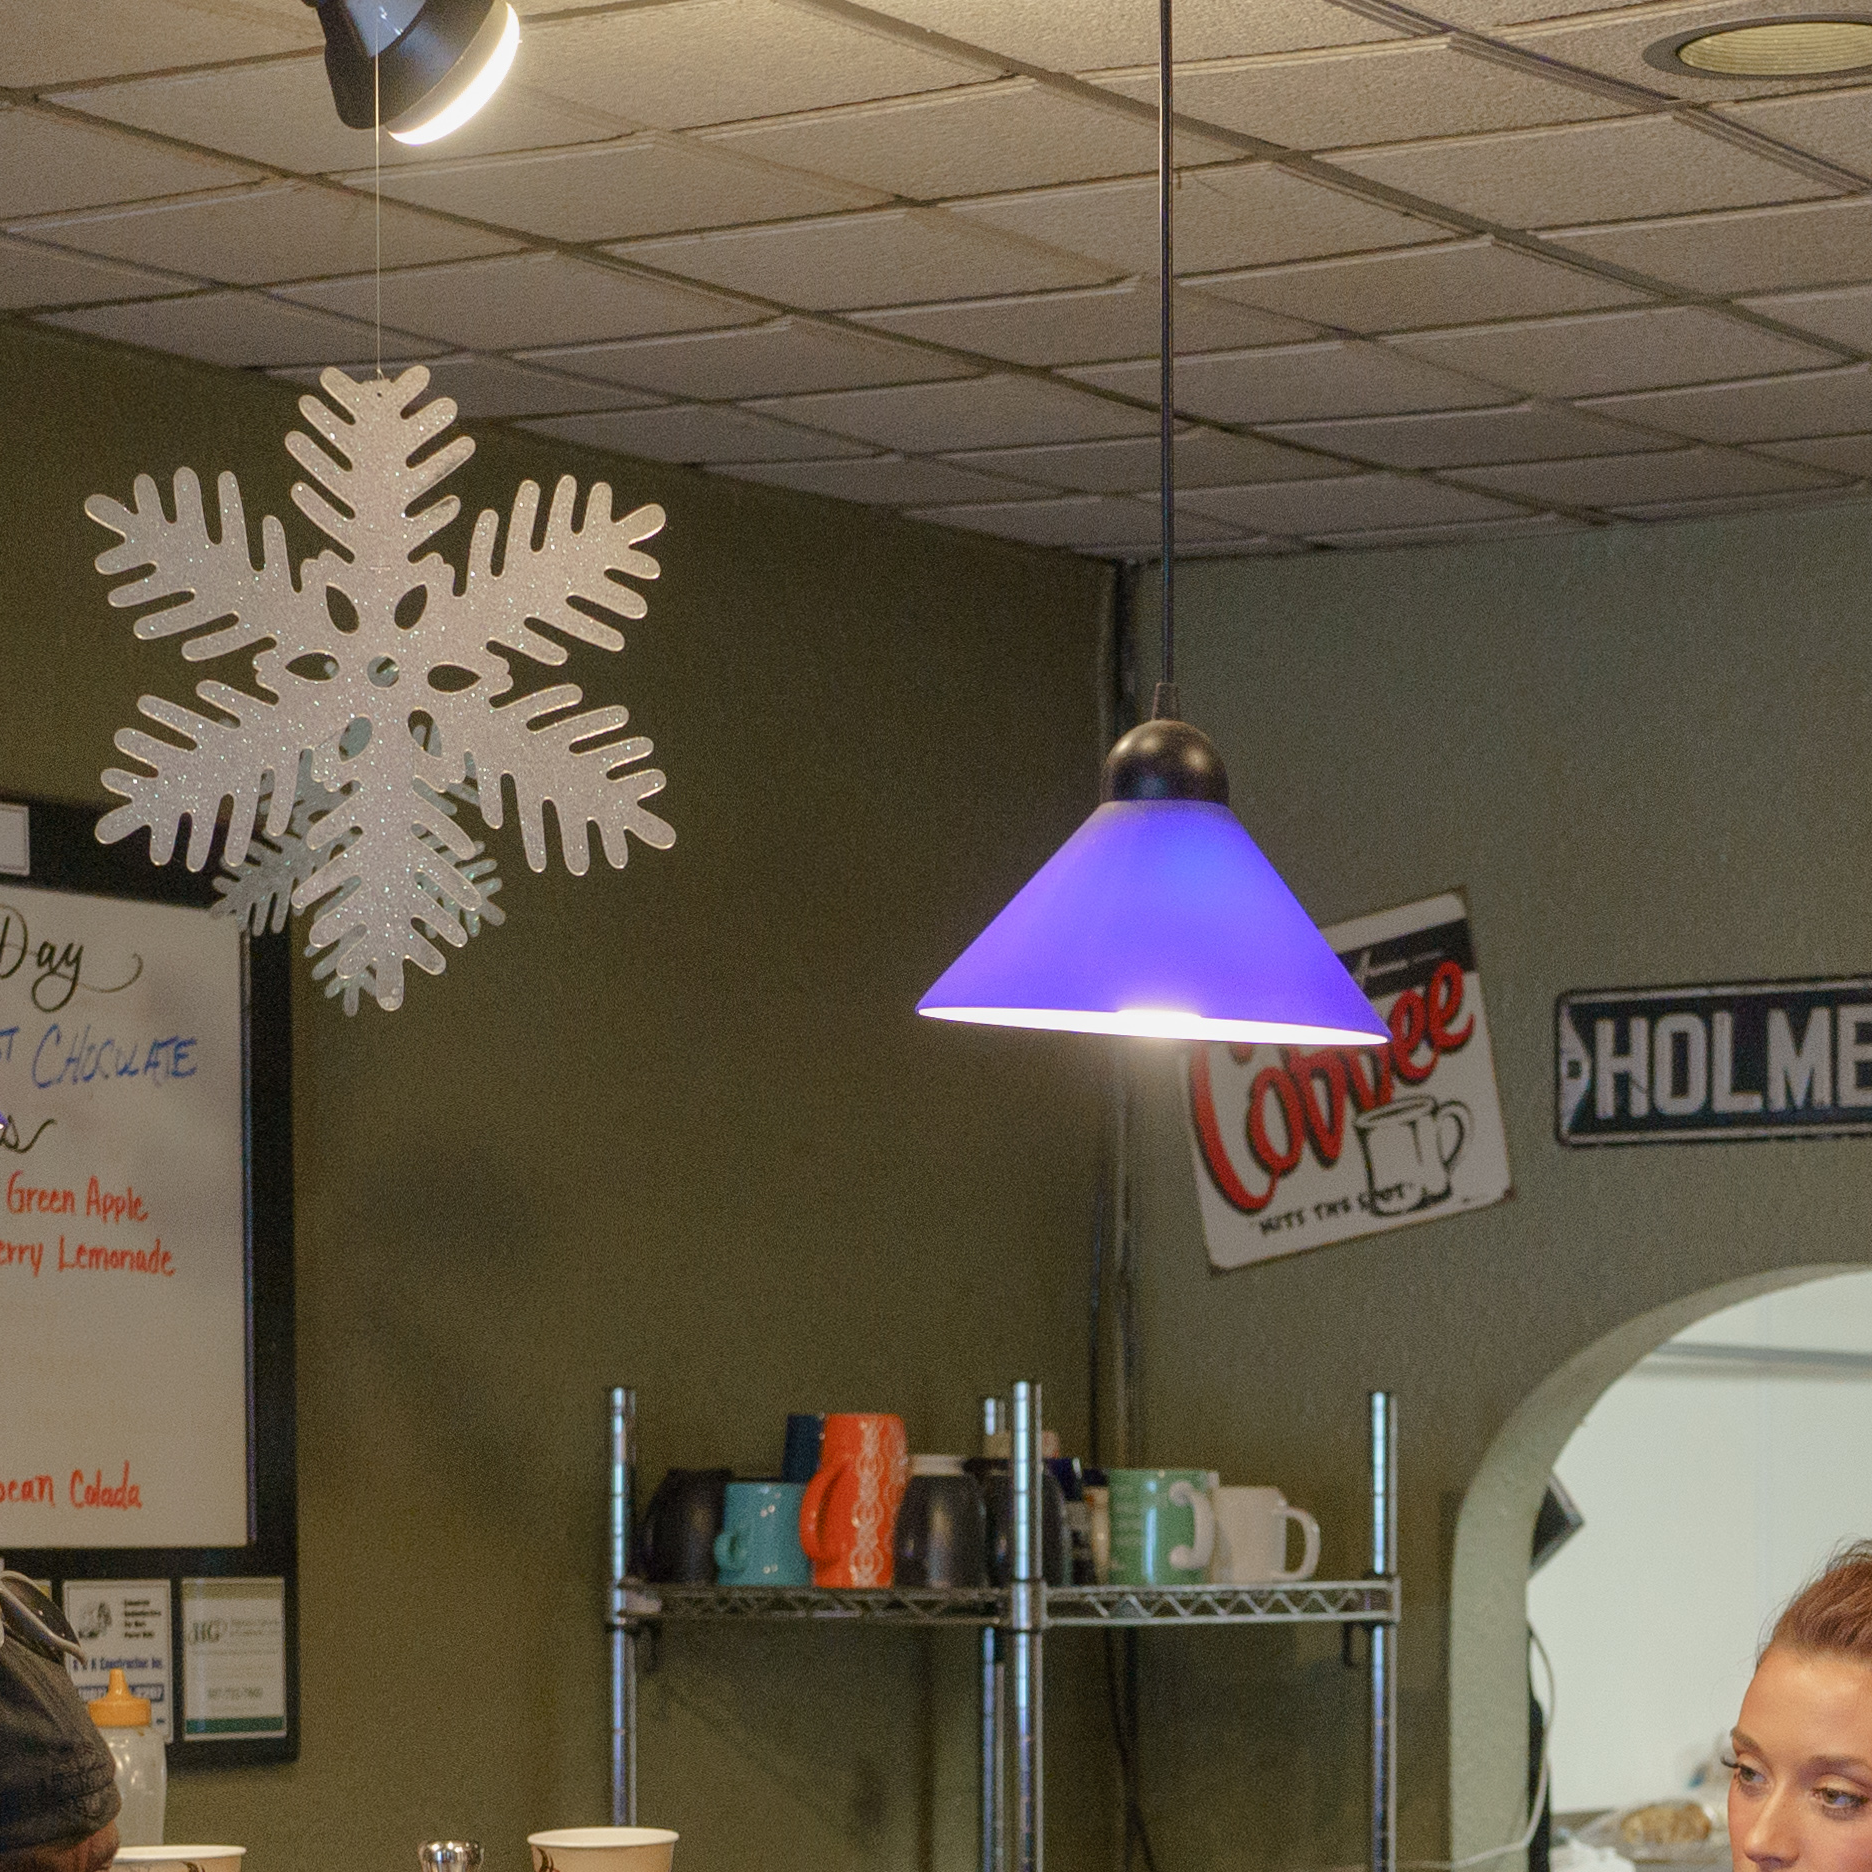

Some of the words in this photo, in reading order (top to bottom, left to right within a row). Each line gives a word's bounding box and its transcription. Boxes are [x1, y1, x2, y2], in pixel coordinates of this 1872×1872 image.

[7, 1169, 78, 1217] Green
[85, 1175, 150, 1226] Apple
[56, 1235, 177, 1278] Lemonade
[68, 1462, 144, 1511] Colada
